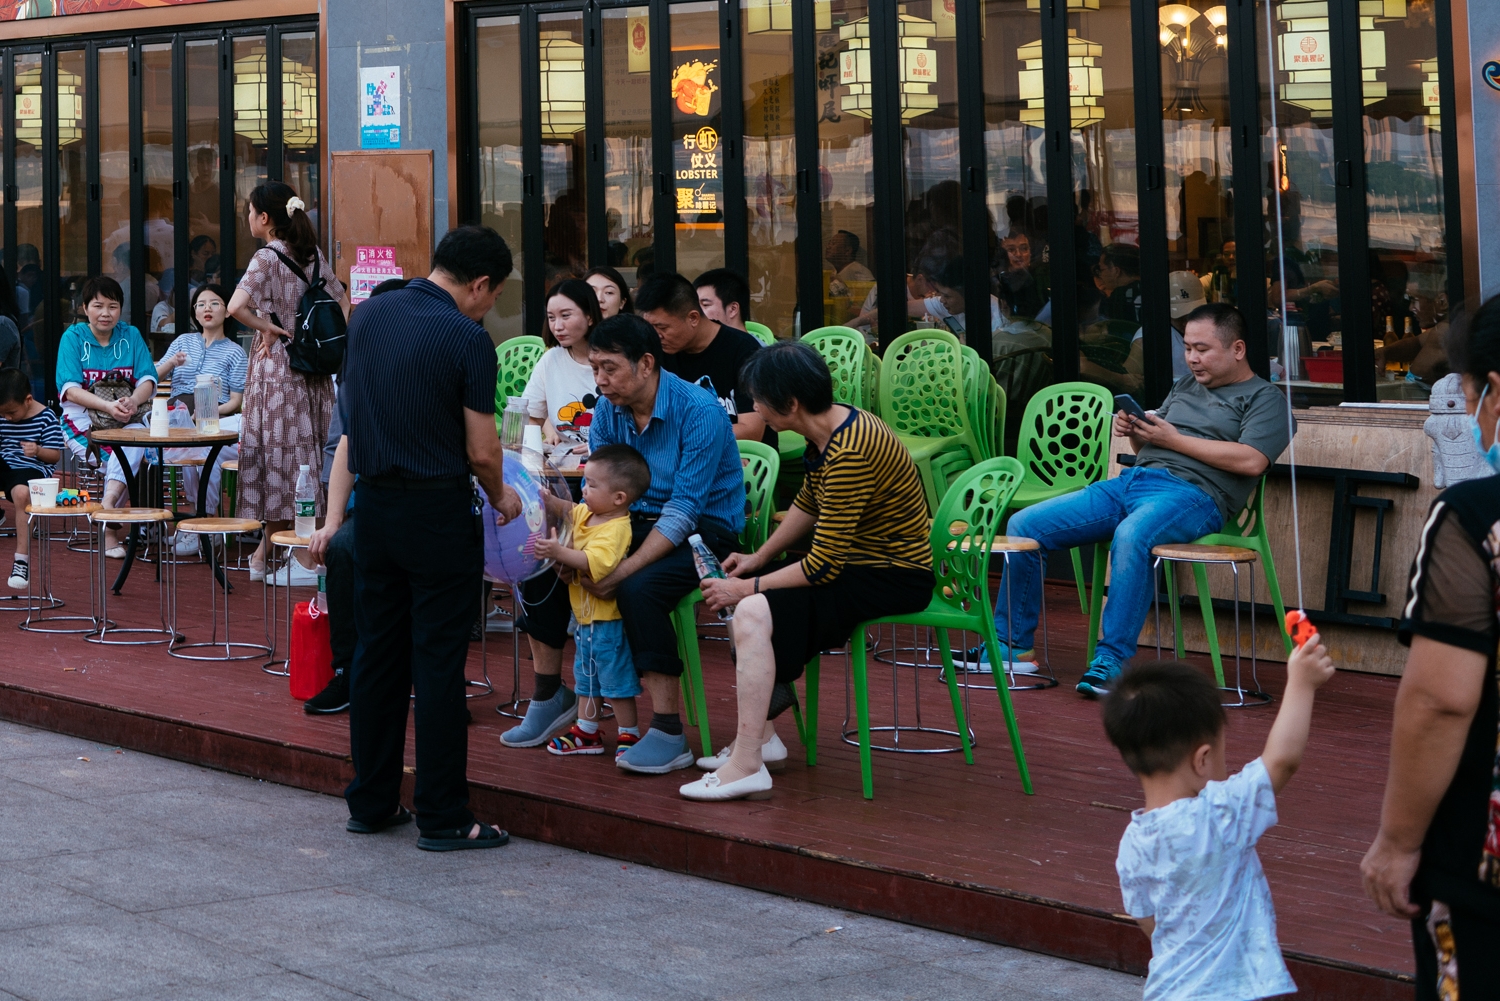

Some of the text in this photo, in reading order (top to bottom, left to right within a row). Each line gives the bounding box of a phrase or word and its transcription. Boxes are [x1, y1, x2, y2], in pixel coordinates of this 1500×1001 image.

[683, 129, 717, 150] 行虾
[690, 152, 717, 169] 仗义
[675, 169, 719, 180] LOBSTER
[676, 187, 694, 209] 聚
[368, 248, 393, 259] 消火栓
